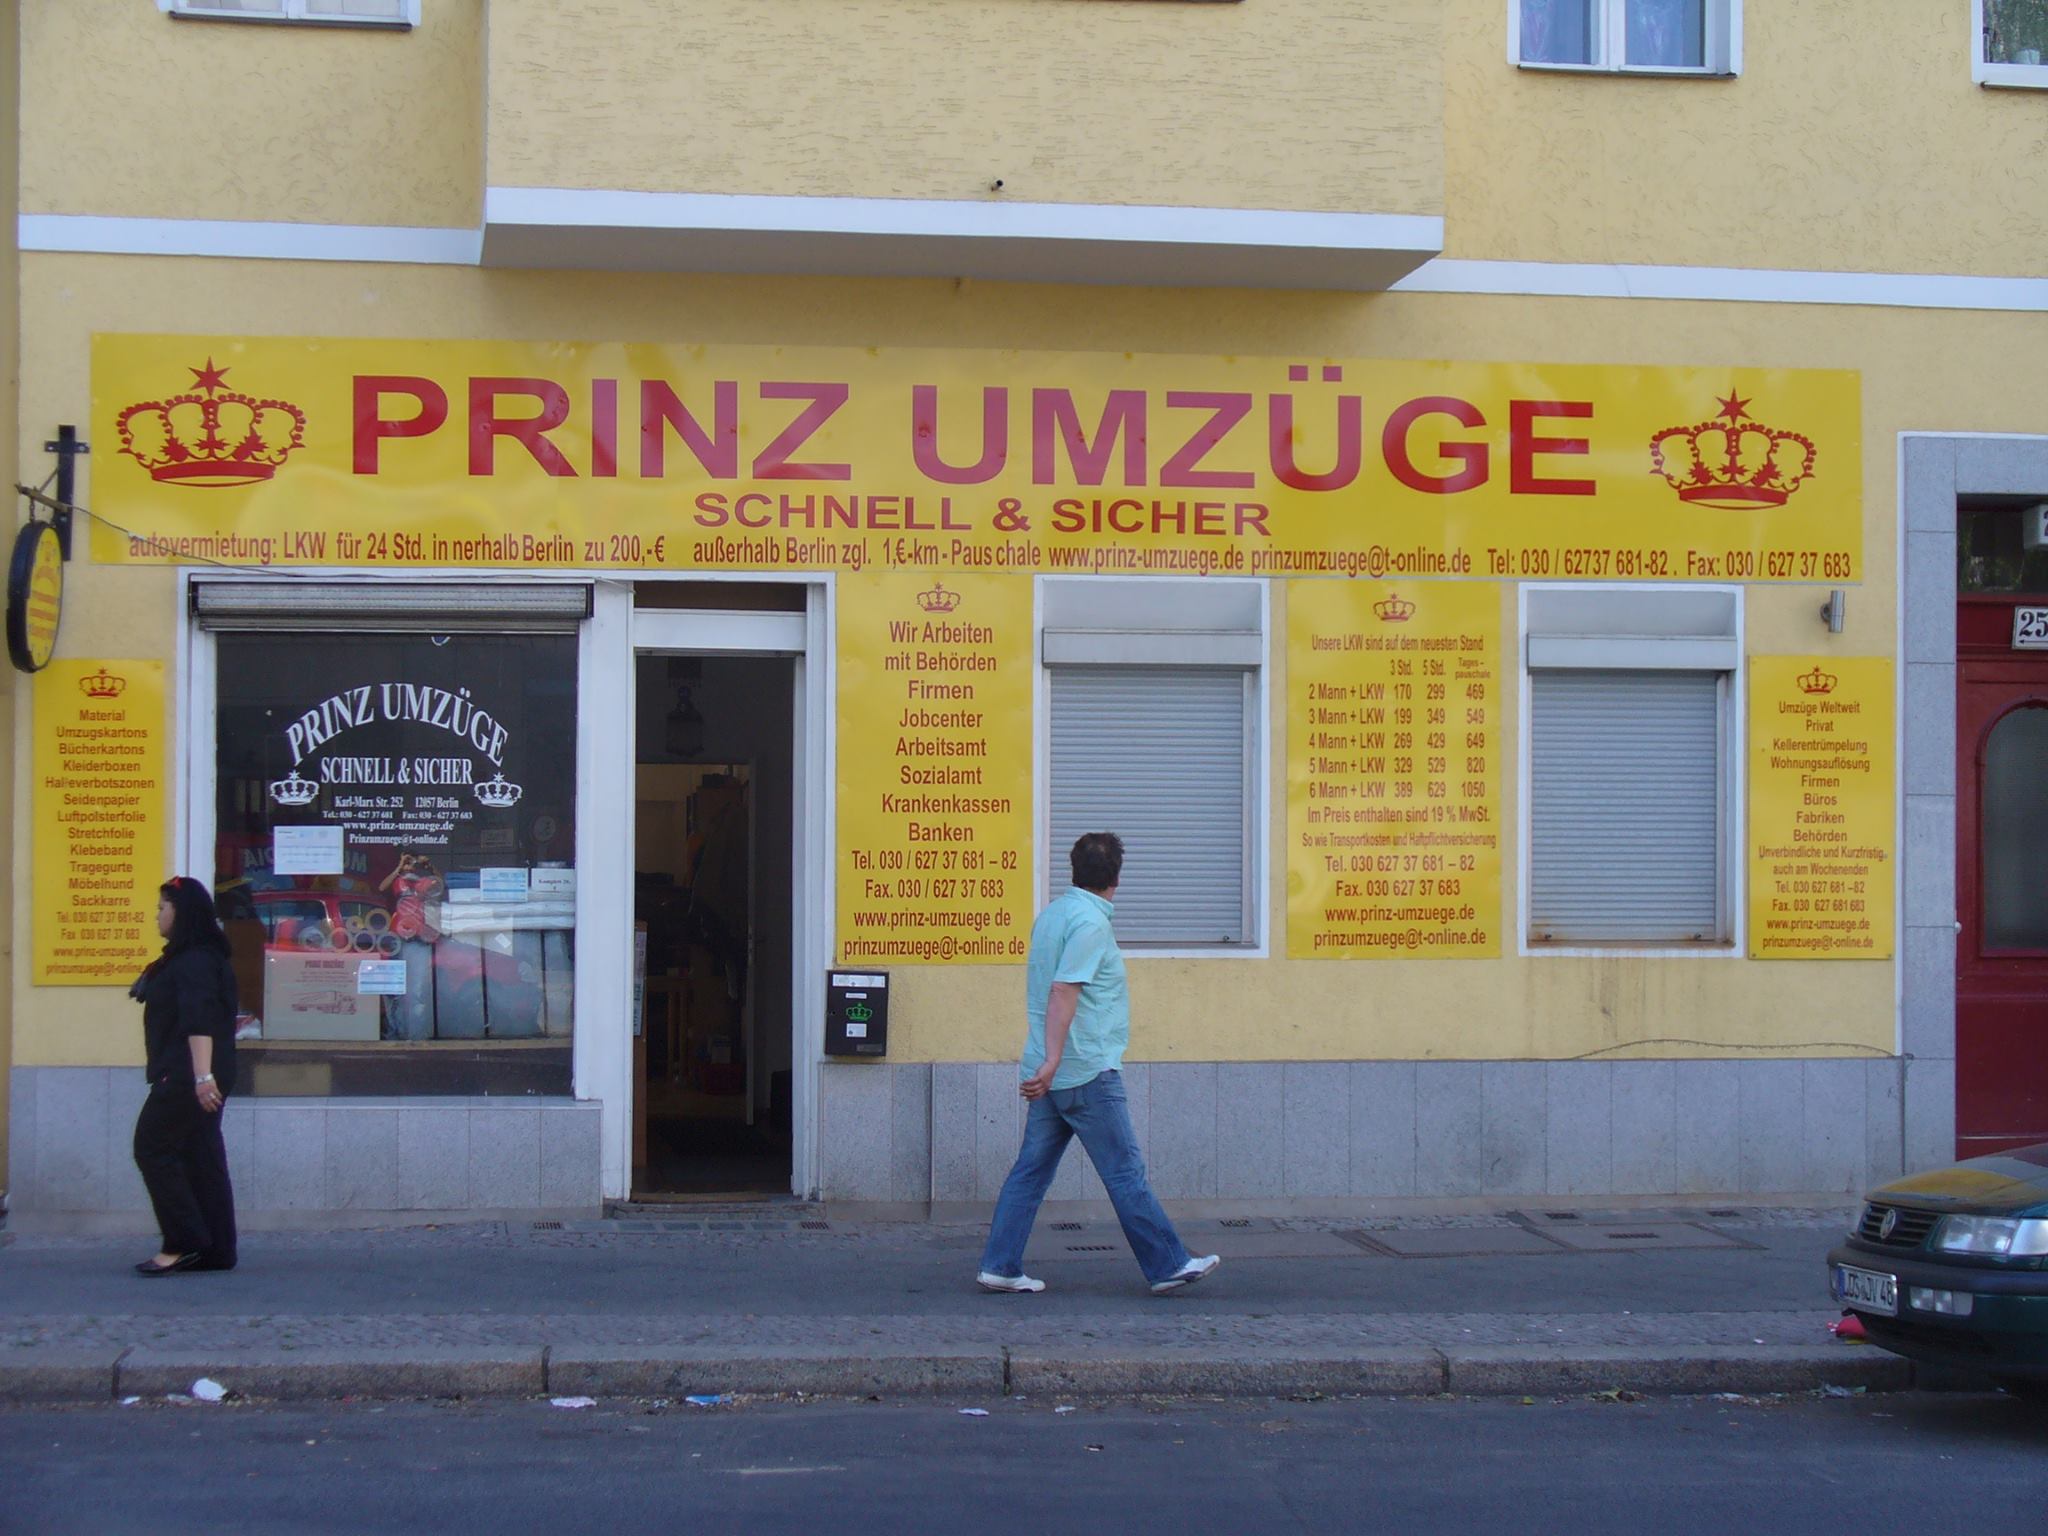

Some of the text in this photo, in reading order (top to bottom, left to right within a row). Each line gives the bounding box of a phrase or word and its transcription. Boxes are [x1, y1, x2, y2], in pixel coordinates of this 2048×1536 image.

[352, 366, 1597, 495] PRINZ UMZÜGE
[693, 493, 1271, 536] SCHNELL & SICHER
[129, 531, 1851, 578] autovermietung: LKW für 24 Std. Berlin zu außerhalb Berlin zgl. www.prinz-umzuege.de prinzumzuege@t-online.de Tel: 030 62737 681-82 Fax: 030 627 37 683
[889, 621, 993, 643] Wir Arbeiten
[1312, 635, 1484, 650] Unsere LKW sind auf dem neuesten Stand
[885, 652, 997, 671] mit Behörden
[908, 680, 973, 699] Firmen
[1309, 683, 1485, 700] 2 Mann LKW 170 299 469
[79, 710, 125, 721] Material
[1318, 708, 1485, 724] Mann LKW 199 349 549
[1779, 701, 1860, 716] Umzüge Weltweit
[285, 683, 509, 767] PRINZ UMZÜGE
[899, 708, 983, 728] Jobcenter
[1806, 719, 1834, 732] Privat
[56, 726, 148, 740] Umzugskartons
[1318, 732, 1485, 749] Mann LKW 269 429 649
[59, 743, 145, 755] Bücherkartons
[895, 737, 987, 756] Arbeitsamt
[1773, 738, 1868, 754] Kellerentrümpelung
[63, 760, 140, 772] Kleiderboxen
[321, 757, 473, 785] SCHNELL & SICHER
[1318, 757, 1485, 773] Mann LKW 329 529 820
[1771, 756, 1870, 772] Wohnungsauflösung
[901, 765, 982, 785] Sozialamt
[1801, 775, 1840, 787] Firmen
[1318, 782, 1485, 798] Mann LKW 389 629 1050
[64, 793, 140, 807] Seidenpapier
[882, 794, 1011, 813] Krankenkassen
[1804, 793, 1837, 805] Büros
[57, 810, 146, 824] Luftpolsterfolie
[1308, 806, 1490, 823] Im Preis enthalten sind 19 MwSt.
[1796, 811, 1845, 824] Fabriken
[68, 827, 135, 839] Stretchfolie
[343, 821, 454, 832] www.prinz-umzuege.de
[909, 822, 974, 842] Banken
[1329, 833, 1390, 849] Transportkosten
[1393, 833, 1407, 847] und
[1793, 829, 1847, 842] Behörden
[70, 844, 133, 856] Klebeband
[1759, 846, 1821, 858] Unverbindliche
[1823, 847, 1839, 858] und
[69, 861, 133, 875] Tragegurte
[852, 850, 1017, 870] Tel. 030 627 37 681 82
[1325, 855, 1475, 871] Tel. 030 627 37 681 82
[1773, 863, 1868, 875] auch am Wochenenden
[68, 878, 133, 889] Möbelhund
[865, 879, 1004, 898] Fax. 030 627 37 683
[1336, 880, 1460, 896] Fax. 030 627 37 683
[1775, 881, 1865, 893] Tel. 030 627 681 –82
[72, 895, 130, 907] Sackkarre
[1325, 904, 1475, 924] www.prinz-umzuege.de
[1767, 918, 1870, 932] www.prinz-umzuege.de
[1314, 928, 1486, 950] prinzumzuege@t-online.de
[1763, 935, 1873, 950] prinzumzuege@t-online.de
